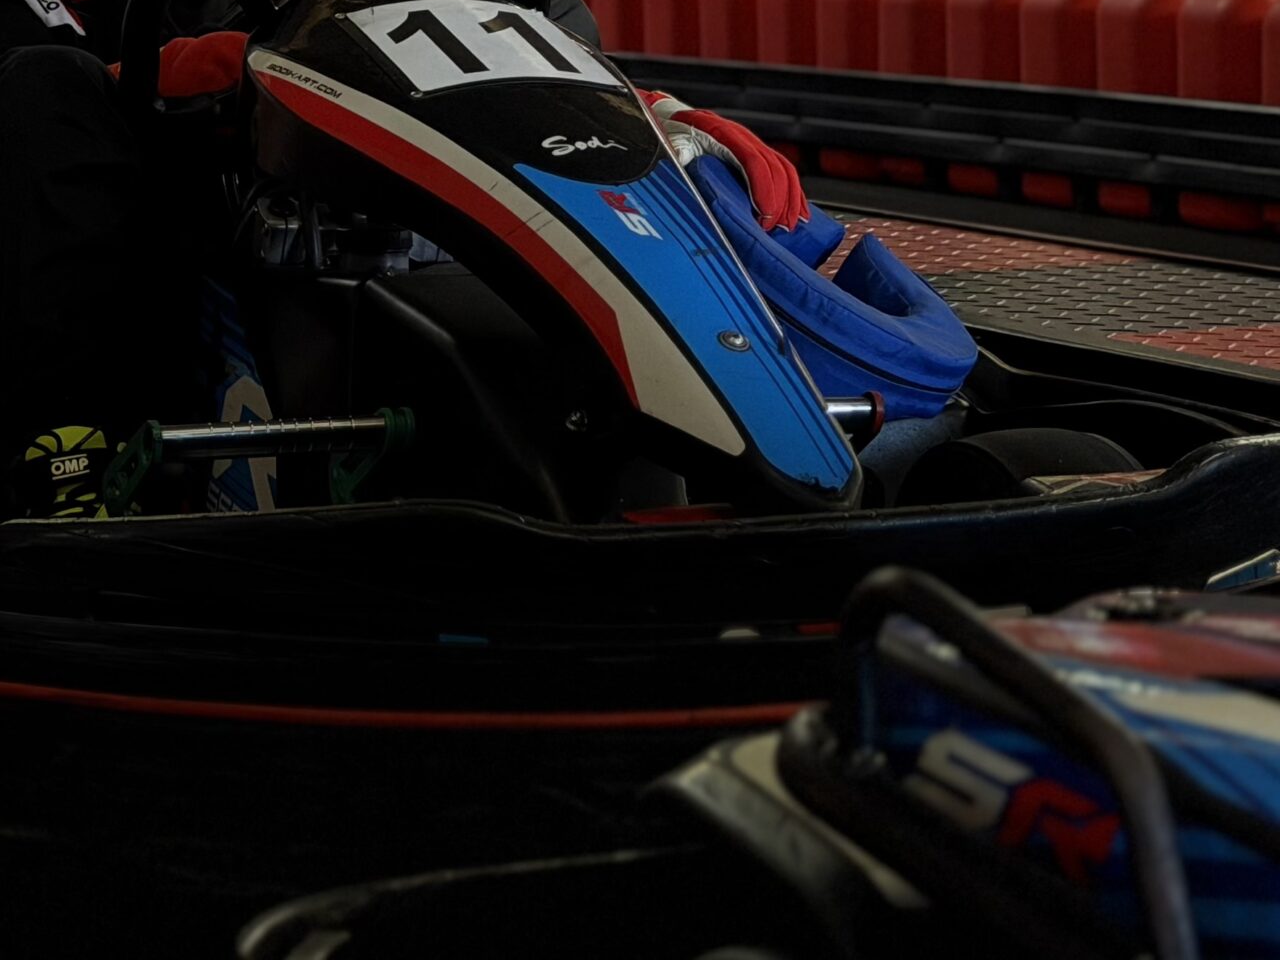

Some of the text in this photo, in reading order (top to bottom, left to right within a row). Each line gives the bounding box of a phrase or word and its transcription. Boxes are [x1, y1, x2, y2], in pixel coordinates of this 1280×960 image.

[387, 9, 581, 74] 11
[541, 135, 629, 156] Sodi
[51, 457, 89, 475] OMP
